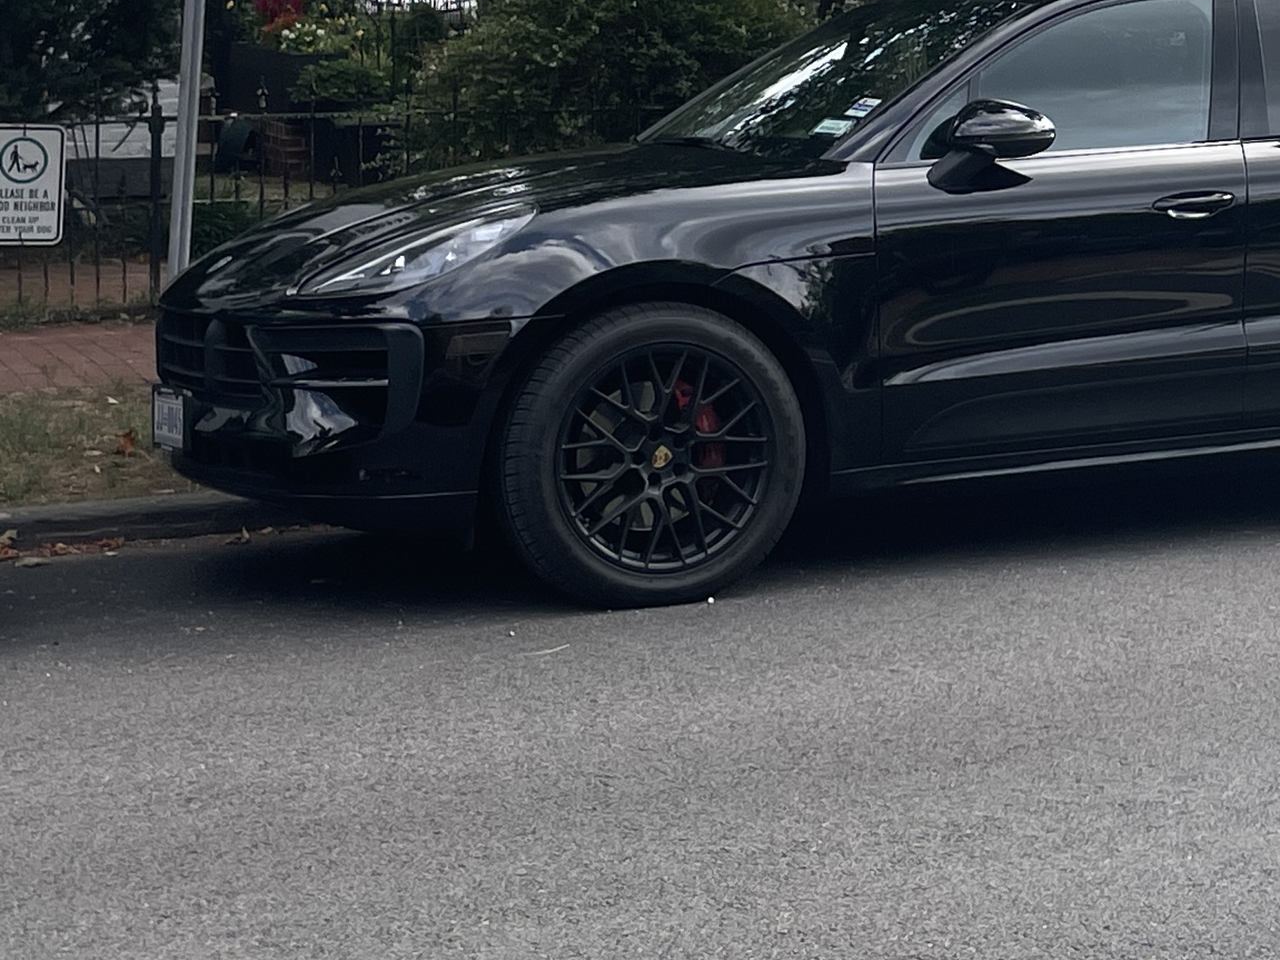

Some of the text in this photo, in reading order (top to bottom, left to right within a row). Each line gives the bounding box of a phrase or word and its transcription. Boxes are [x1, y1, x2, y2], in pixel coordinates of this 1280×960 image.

[0, 188, 49, 200] LEASE BE A
[0, 200, 56, 211] OD NEIGHBOR
[2, 216, 39, 224] CLEAN UP
[14, 225, 34, 233] YOUR
[37, 225, 52, 234] DOG
